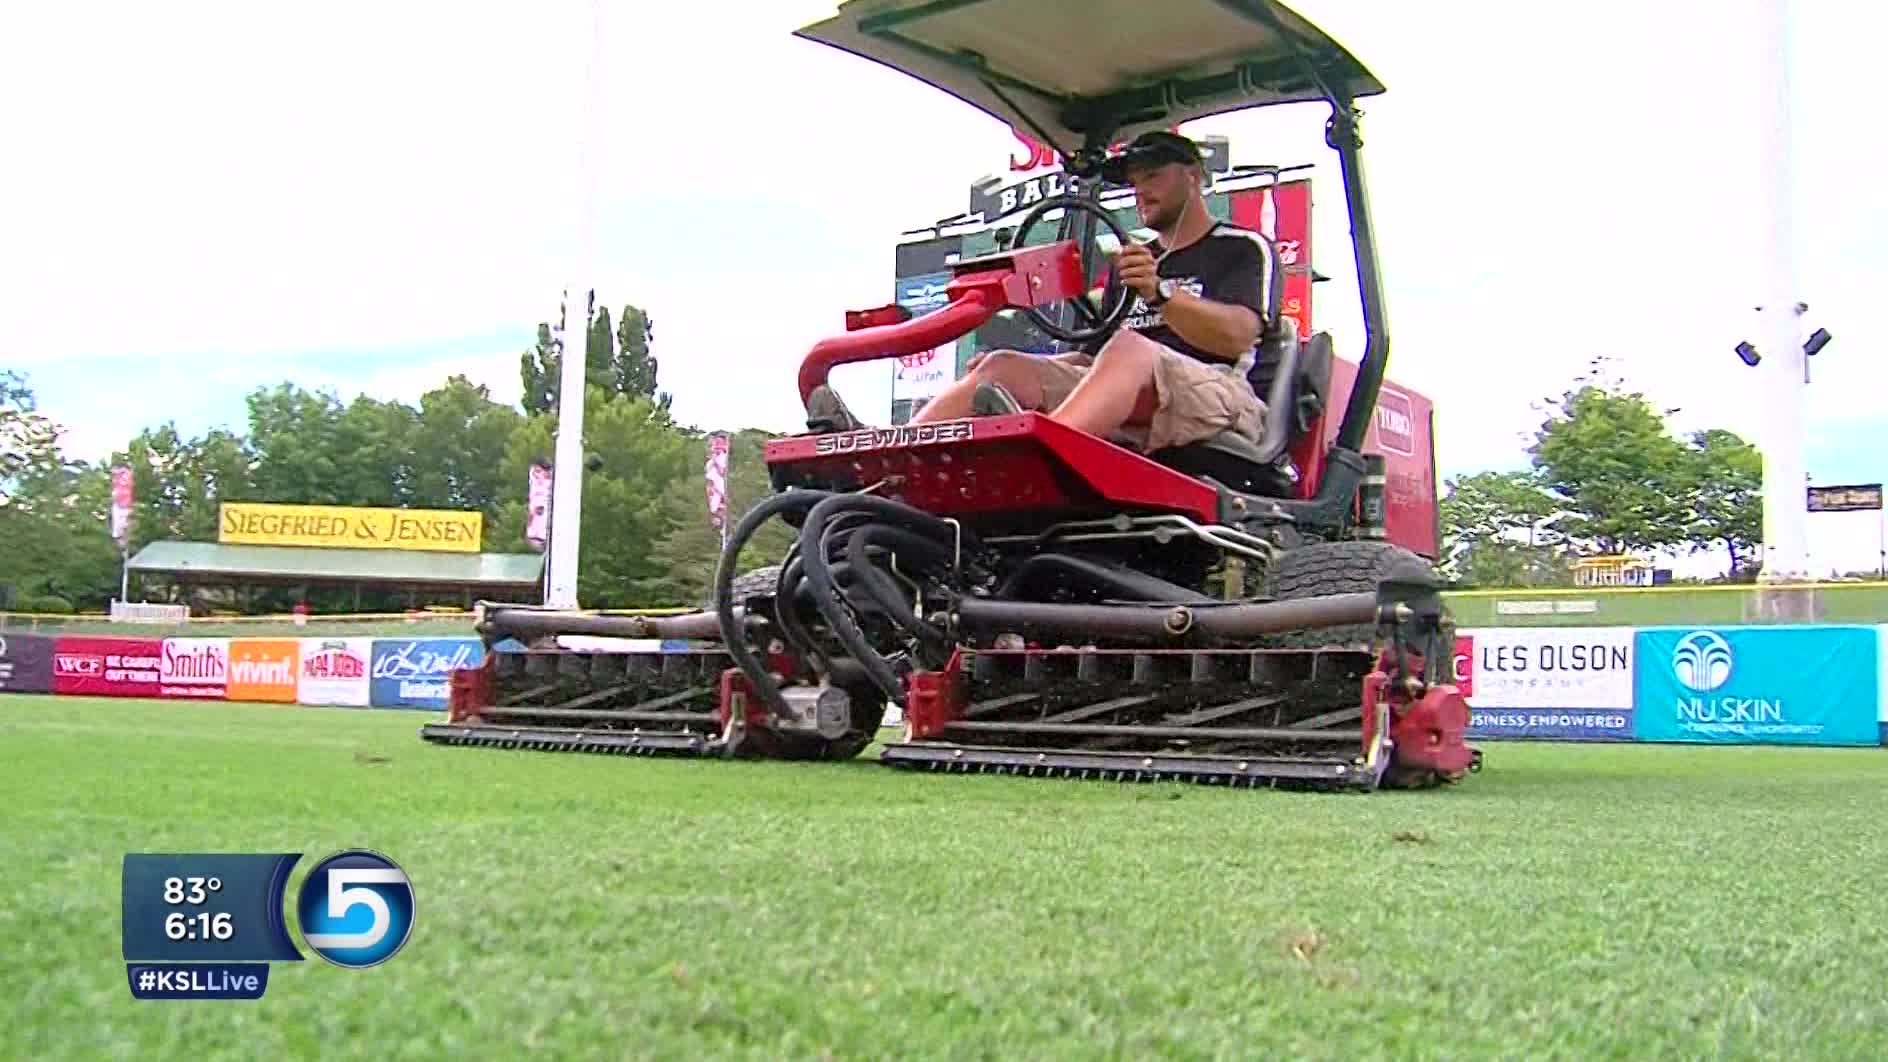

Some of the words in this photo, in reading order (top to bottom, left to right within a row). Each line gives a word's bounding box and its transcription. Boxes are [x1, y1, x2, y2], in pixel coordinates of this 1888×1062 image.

[815, 422, 974, 455] SIDEWINDER
[223, 508, 348, 535] SIEGFRIED
[354, 513, 377, 540] &
[384, 513, 478, 543] JENSEN
[163, 641, 224, 678] Smith's
[1482, 645, 1528, 672] LES
[1539, 644, 1627, 672] OLSON
[1529, 715, 1626, 729] EMPOWERED
